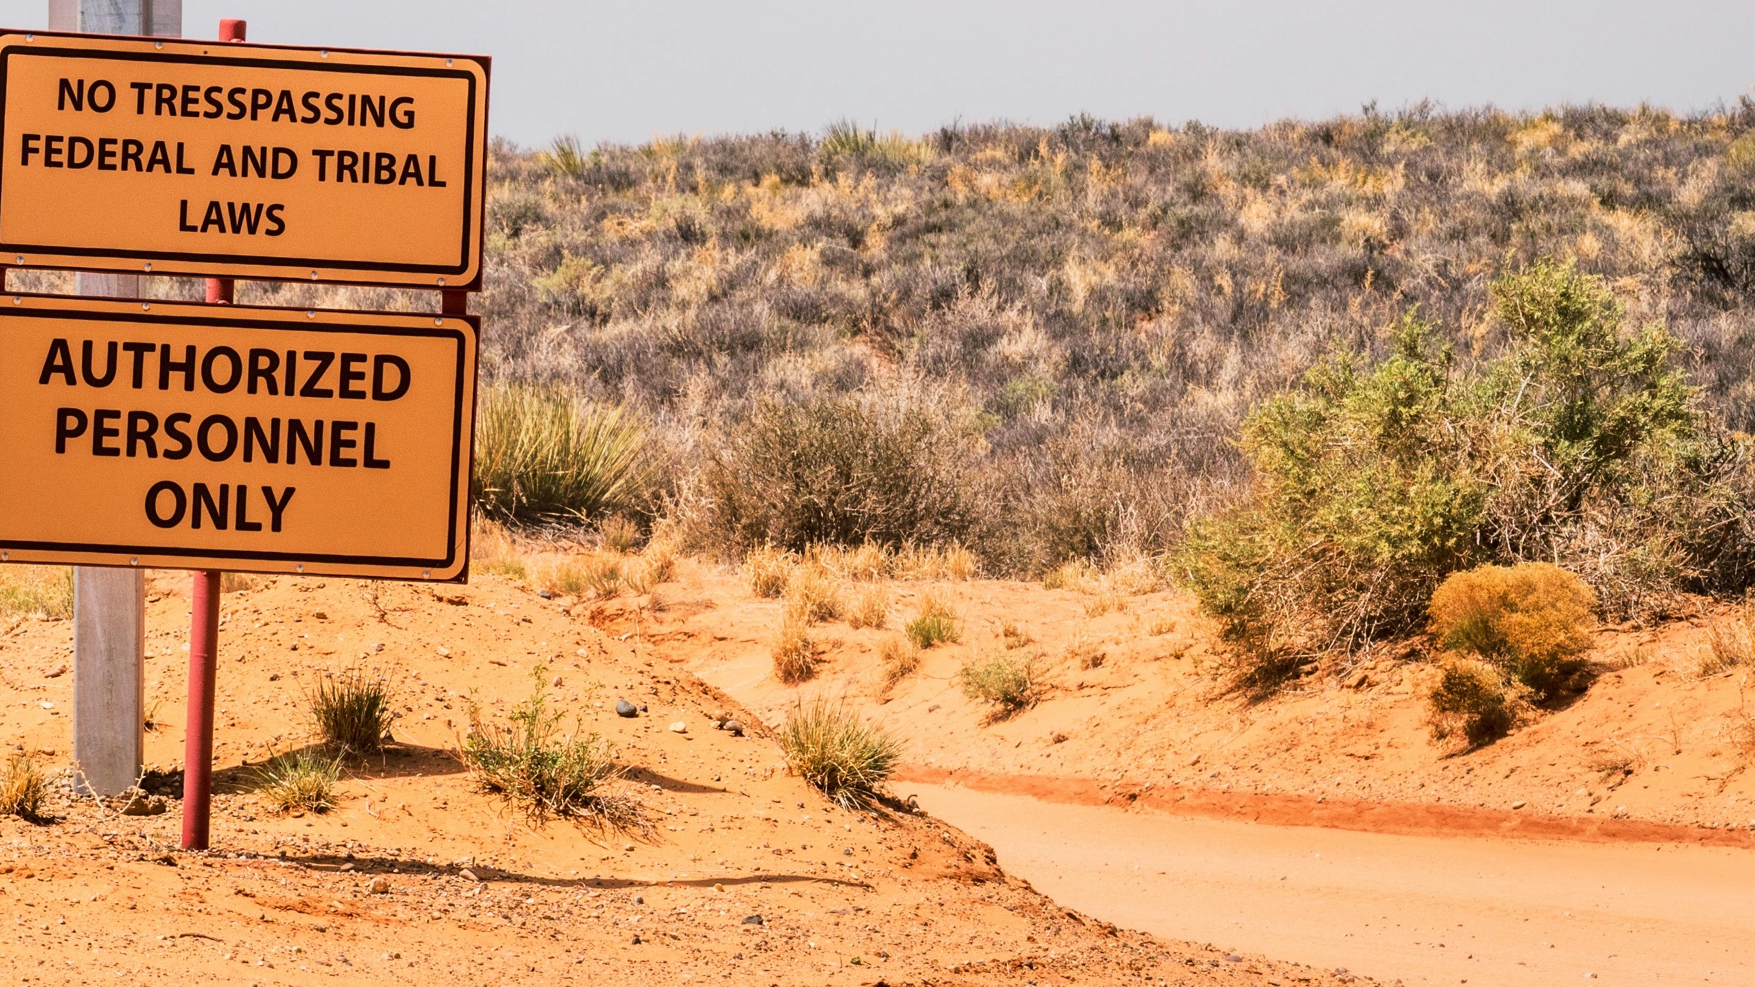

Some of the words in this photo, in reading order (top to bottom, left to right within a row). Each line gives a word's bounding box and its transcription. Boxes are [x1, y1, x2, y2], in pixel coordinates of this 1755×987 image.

[57, 77, 117, 114] NO
[129, 81, 415, 130] TRESSPASSING
[20, 133, 196, 175] FEDERAL
[211, 143, 299, 180] AND
[311, 149, 447, 188] TRIBAL
[179, 199, 286, 237] LAWS
[38, 338, 412, 402] AUTHORIZED
[55, 407, 391, 470] PERSONNEL
[144, 480, 297, 533] ONLY
